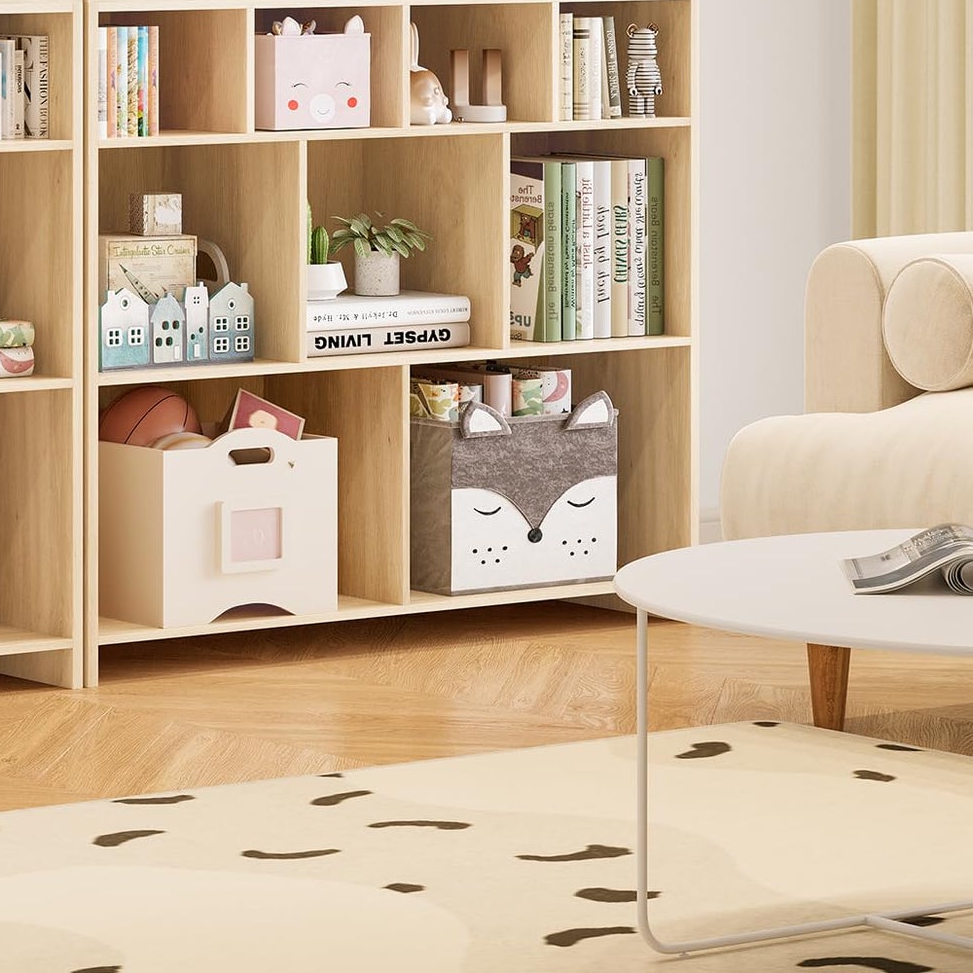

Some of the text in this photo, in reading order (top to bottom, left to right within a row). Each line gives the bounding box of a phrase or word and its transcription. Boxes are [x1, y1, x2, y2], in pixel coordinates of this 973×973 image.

[39, 38, 48, 137] THE FASHION BOOK
[314, 328, 451, 350] GYPSET LIVING
